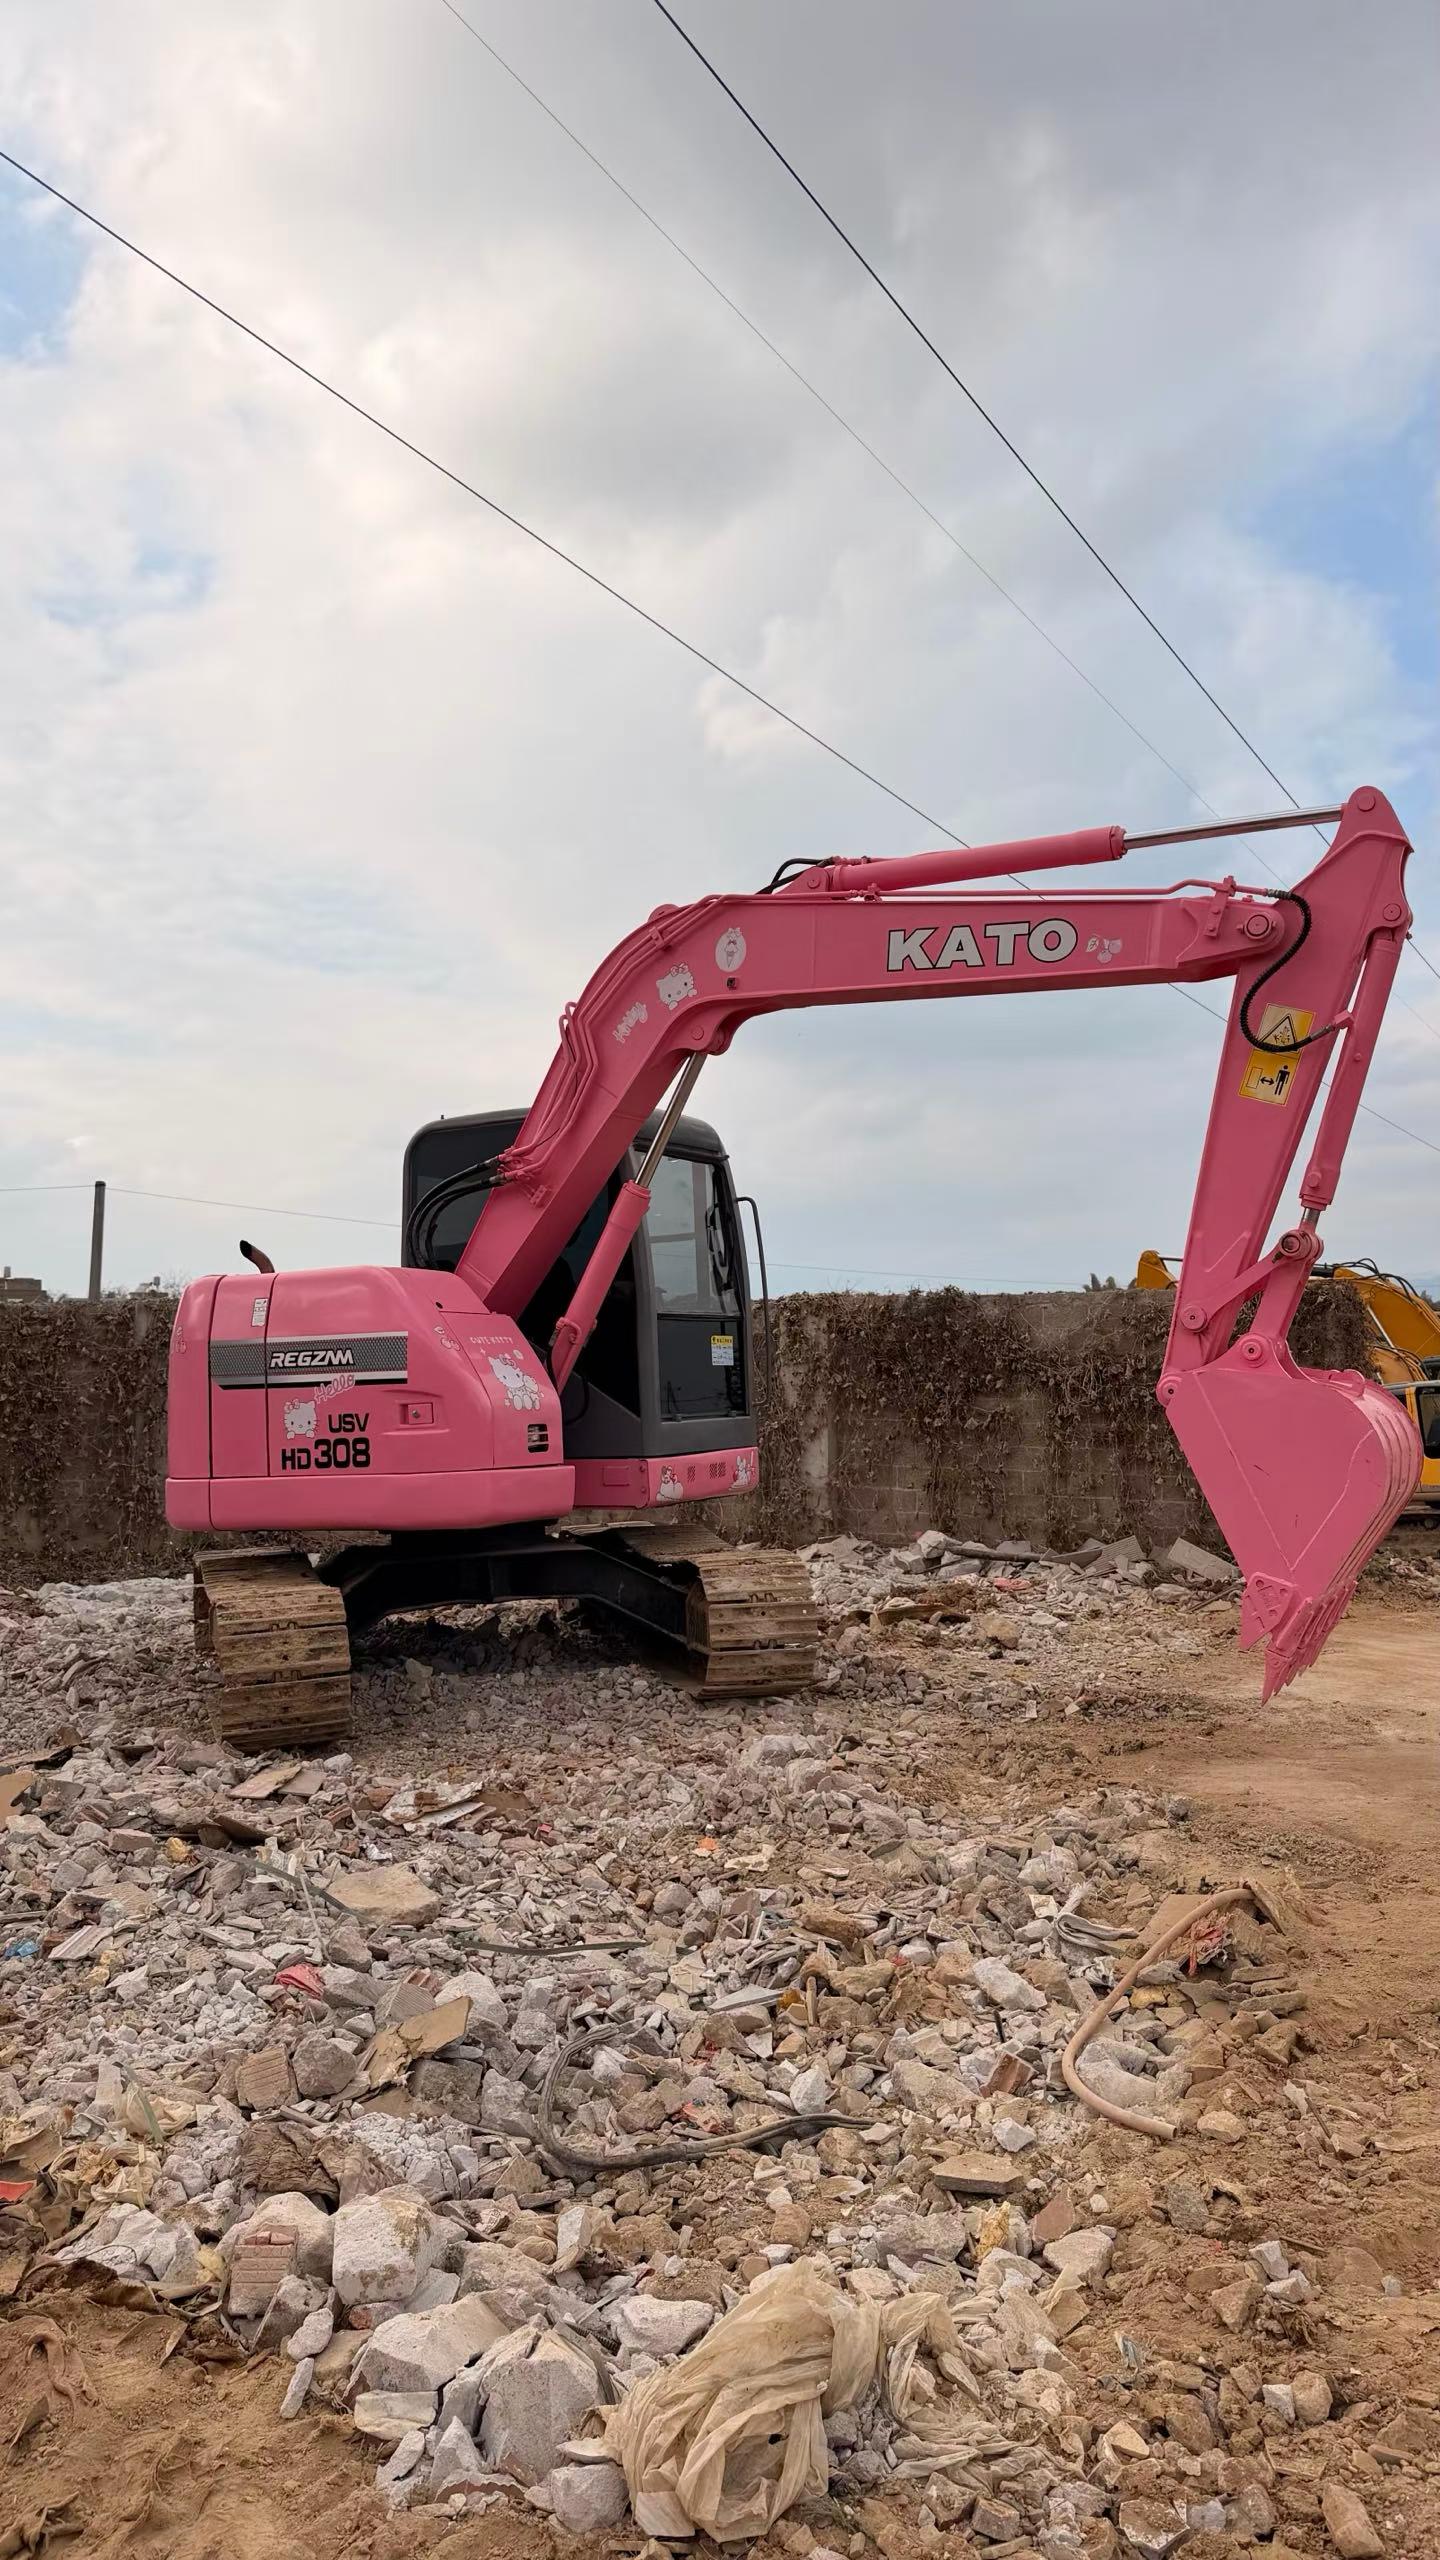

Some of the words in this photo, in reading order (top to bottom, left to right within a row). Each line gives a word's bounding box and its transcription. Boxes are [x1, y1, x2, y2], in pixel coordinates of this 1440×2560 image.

[887, 918, 1078, 972] KATO
[313, 1373, 356, 1404] Hello
[327, 1412, 370, 1434] USV
